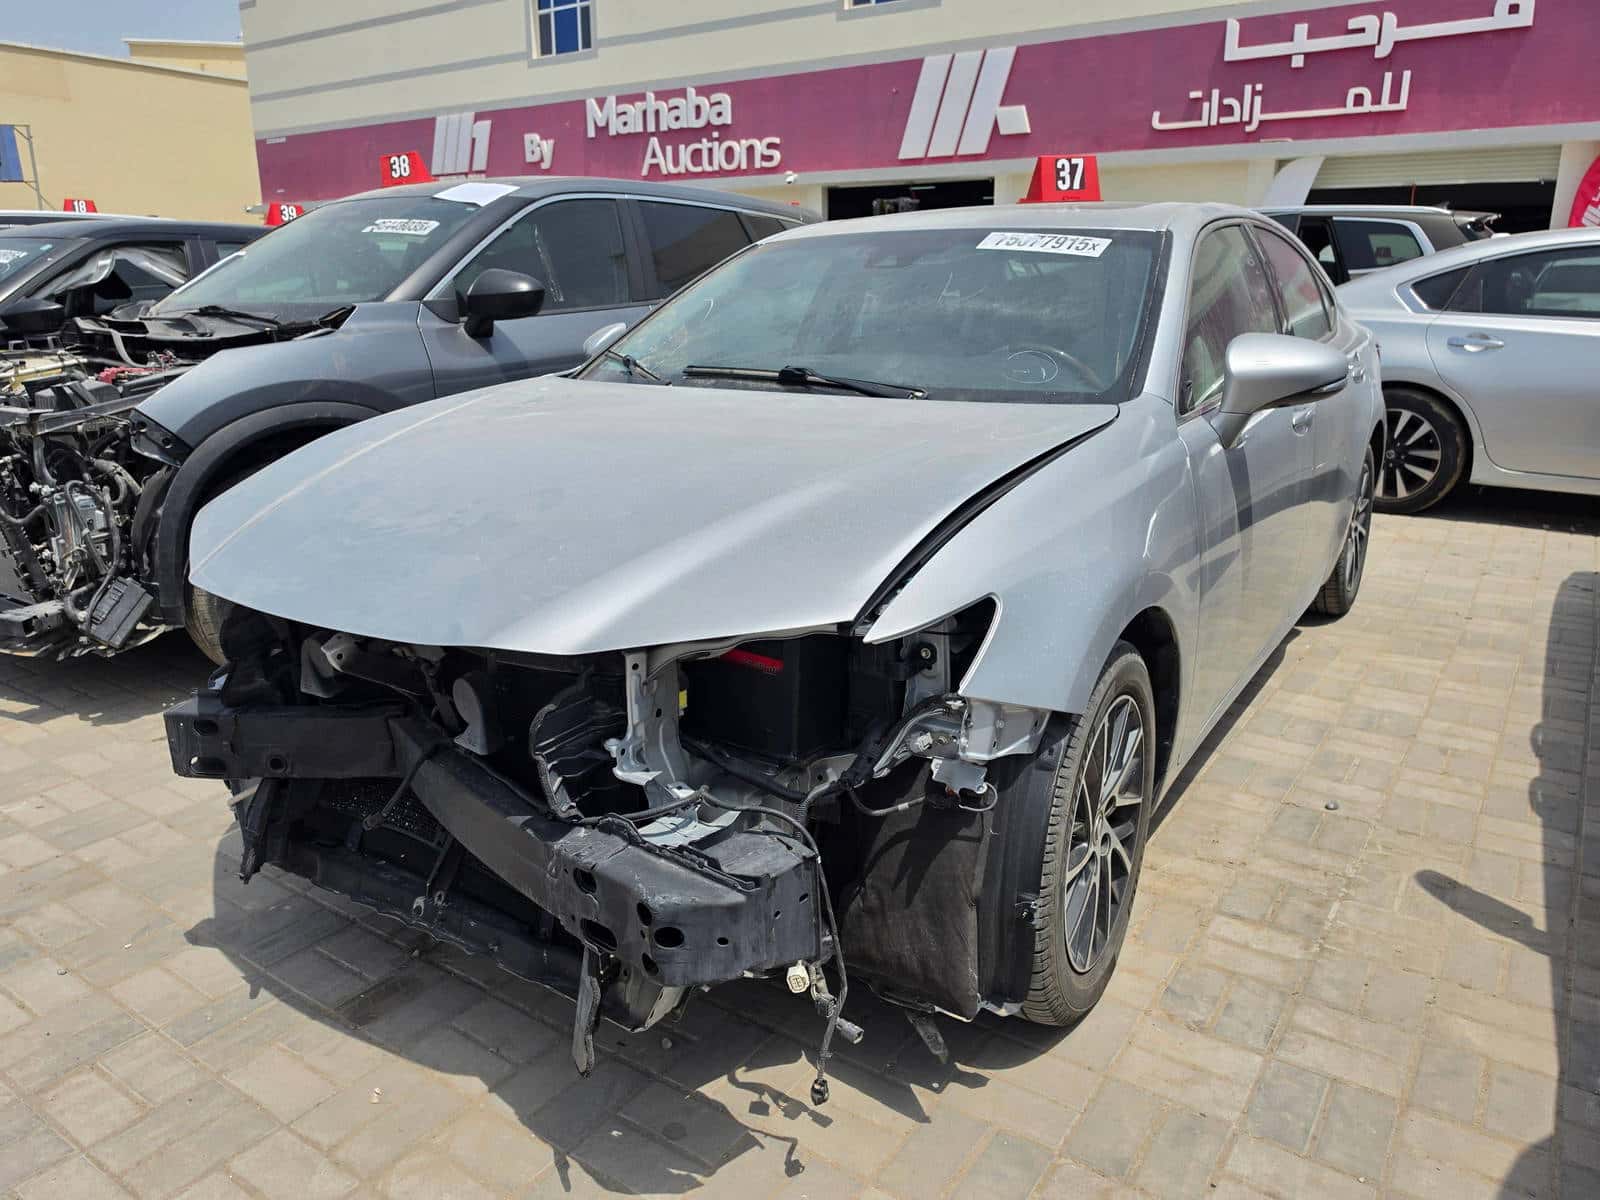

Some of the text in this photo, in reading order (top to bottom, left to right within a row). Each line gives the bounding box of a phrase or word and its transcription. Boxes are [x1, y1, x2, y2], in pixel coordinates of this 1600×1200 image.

[1223, 0, 1535, 69] مرحبا
[585, 86, 733, 139] Marhaba
[1151, 69, 1412, 133] للمزادات
[389, 154, 411, 179] 38
[524, 132, 555, 170] By
[640, 131, 781, 177] Auctions
[1056, 157, 1084, 191] 37
[73, 199, 88, 213] 18
[280, 204, 298, 222] 39
